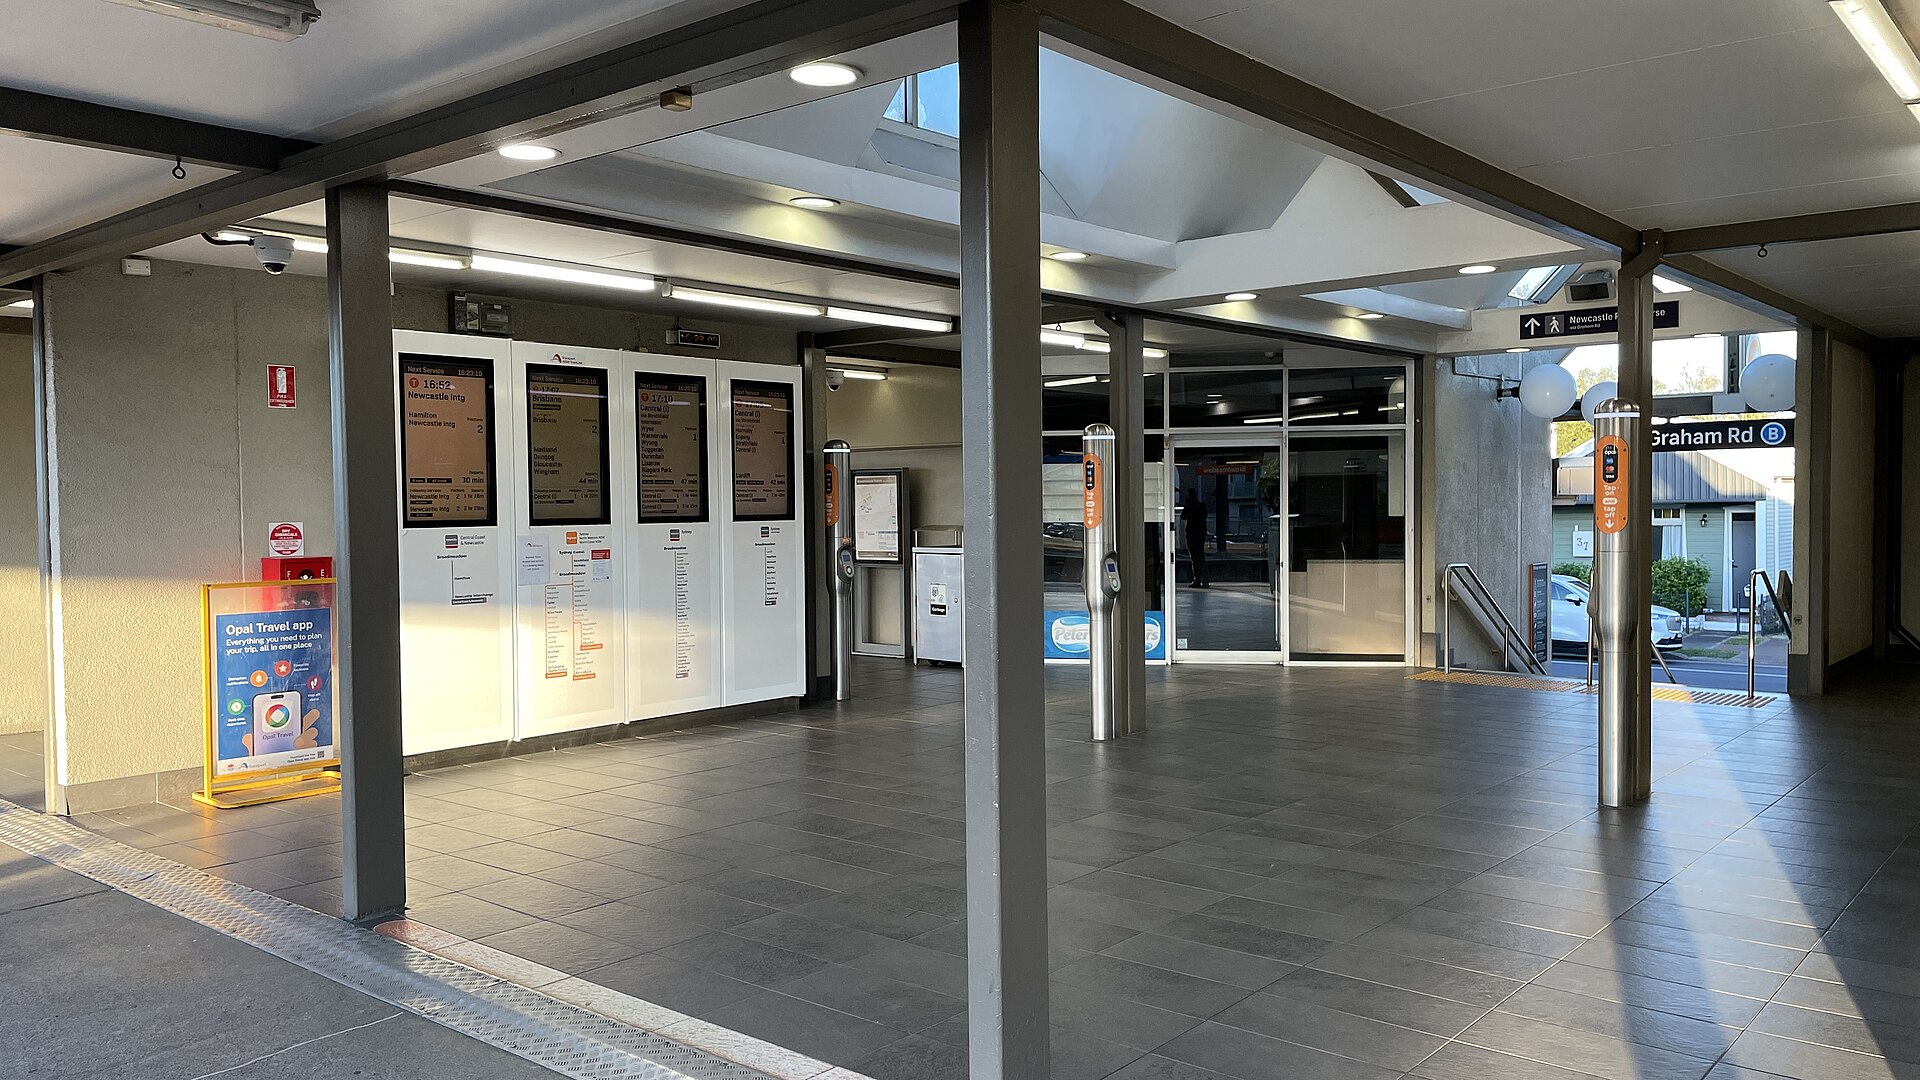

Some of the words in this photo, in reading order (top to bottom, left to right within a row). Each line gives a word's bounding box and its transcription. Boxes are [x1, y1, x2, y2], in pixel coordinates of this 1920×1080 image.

[1570, 313, 1613, 323] Newcastle
[424, 380, 451, 390] 16:52
[408, 391, 449, 401] Newcastle
[451, 393, 466, 403] Intg
[477, 424, 483, 434] 2
[1728, 426, 1753, 443] Rd
[226, 623, 254, 636] Opal
[256, 621, 290, 632] Travel
[292, 622, 313, 631] app
[226, 638, 264, 647] Everything
[308, 633, 322, 642] plan
[244, 646, 258, 654] trip,
[294, 642, 312, 650] place
